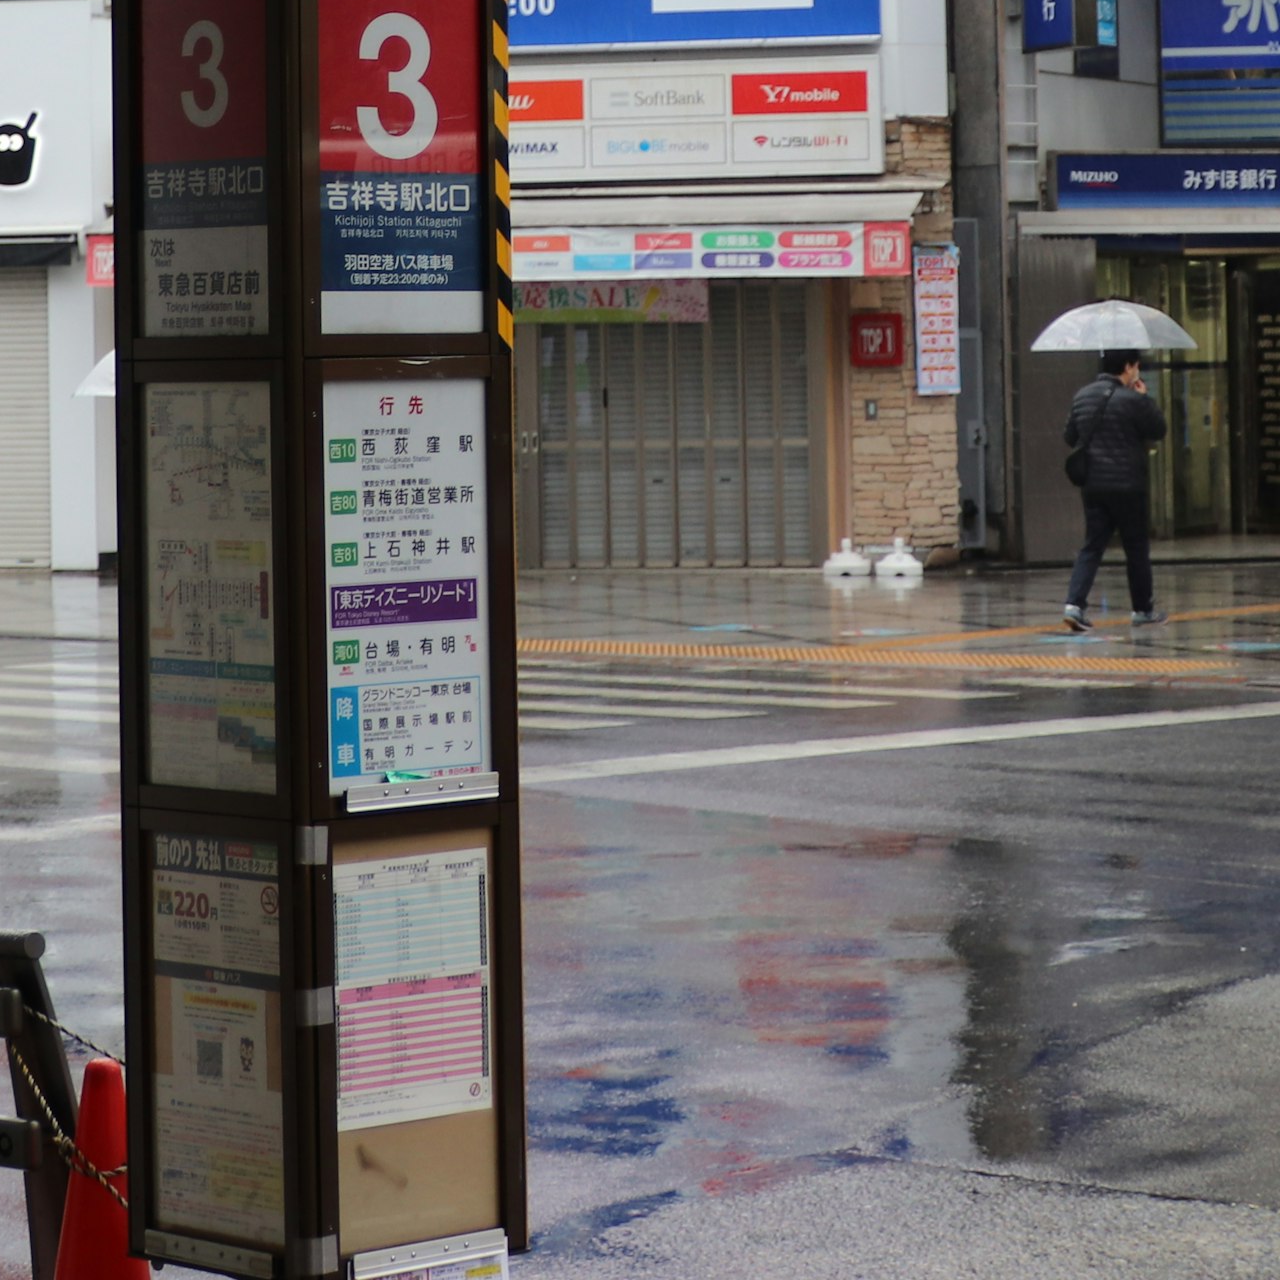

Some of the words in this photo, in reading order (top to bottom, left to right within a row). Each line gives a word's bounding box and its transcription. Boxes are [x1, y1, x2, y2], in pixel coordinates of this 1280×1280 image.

[180, 20, 229, 128] 3
[356, 12, 438, 159] 3
[634, 88, 705, 109] SoftBank
[147, 165, 264, 200] 吉祥寺駅北口
[1070, 171, 1118, 183] MIZUHO
[1183, 169, 1277, 190] みずほ銀行
[326, 180, 470, 213] 吉祥寺駅北口
[335, 215, 375, 228] Kichijoji
[377, 215, 412, 226] Station
[416, 216, 462, 229] Kitaguchi
[150, 238, 175, 258] 次は
[344, 254, 454, 271] 羽田空港バス降車場
[158, 270, 260, 297] 東急百貨店前
[861, 328, 883, 353] TOP
[379, 395, 424, 416] 行先
[330, 443, 356, 460] 西10
[362, 435, 473, 457] 西荻窪駅
[331, 495, 357, 512] 吉80
[363, 485, 474, 508] 青梅街道営業所
[334, 548, 357, 564] 吉81
[363, 536, 476, 559] 上石神井駅
[365, 636, 455, 659] 台場・有明
[363, 683, 449, 702] グランドニッコー東京
[453, 682, 471, 696] 台場
[336, 697, 355, 766] 降車
[363, 711, 472, 731] 国際展示場駅前
[365, 740, 473, 760] 有明ガーデン
[156, 834, 192, 868] 前のり
